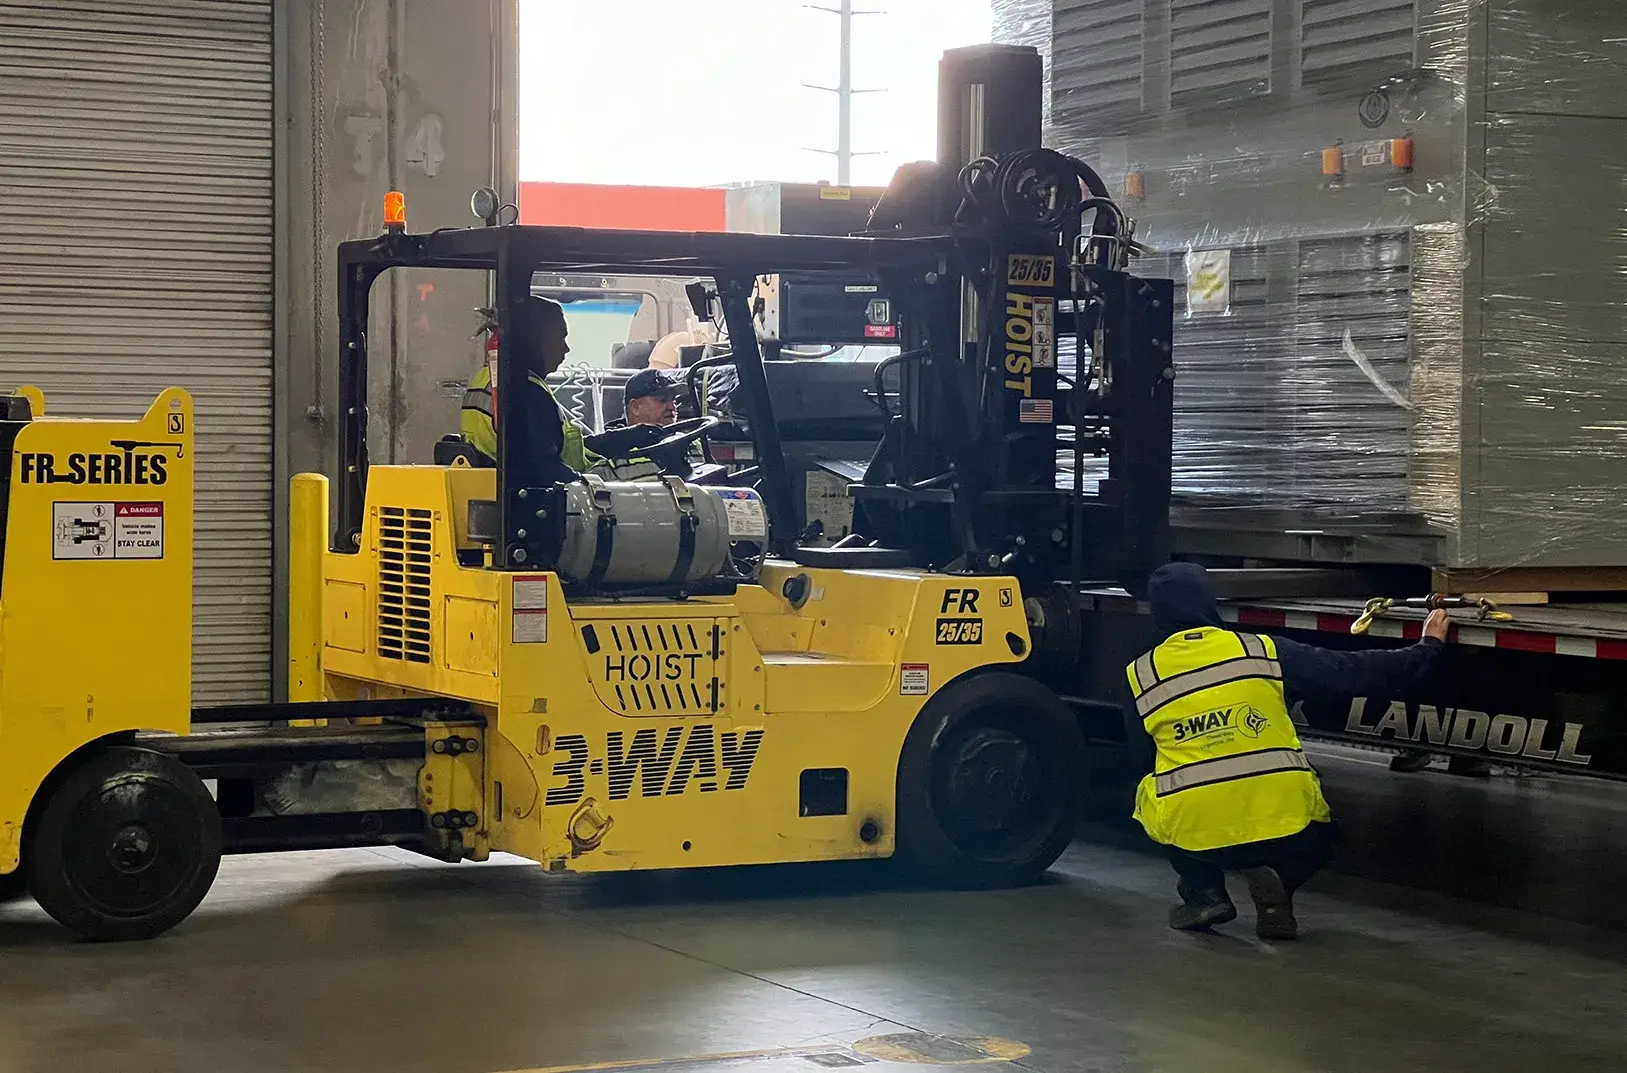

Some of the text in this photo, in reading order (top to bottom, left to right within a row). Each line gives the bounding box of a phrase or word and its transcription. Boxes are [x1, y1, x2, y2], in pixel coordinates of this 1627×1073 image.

[1009, 258, 1052, 282] 25/35
[1005, 292, 1032, 398] HOIST
[940, 588, 980, 614] FR
[937, 622, 982, 642] 25/35
[606, 653, 702, 681] HOIST
[1173, 708, 1233, 741] 3-WAY
[1344, 696, 1592, 765] LANDOLL
[545, 724, 765, 806] 3-WAY
